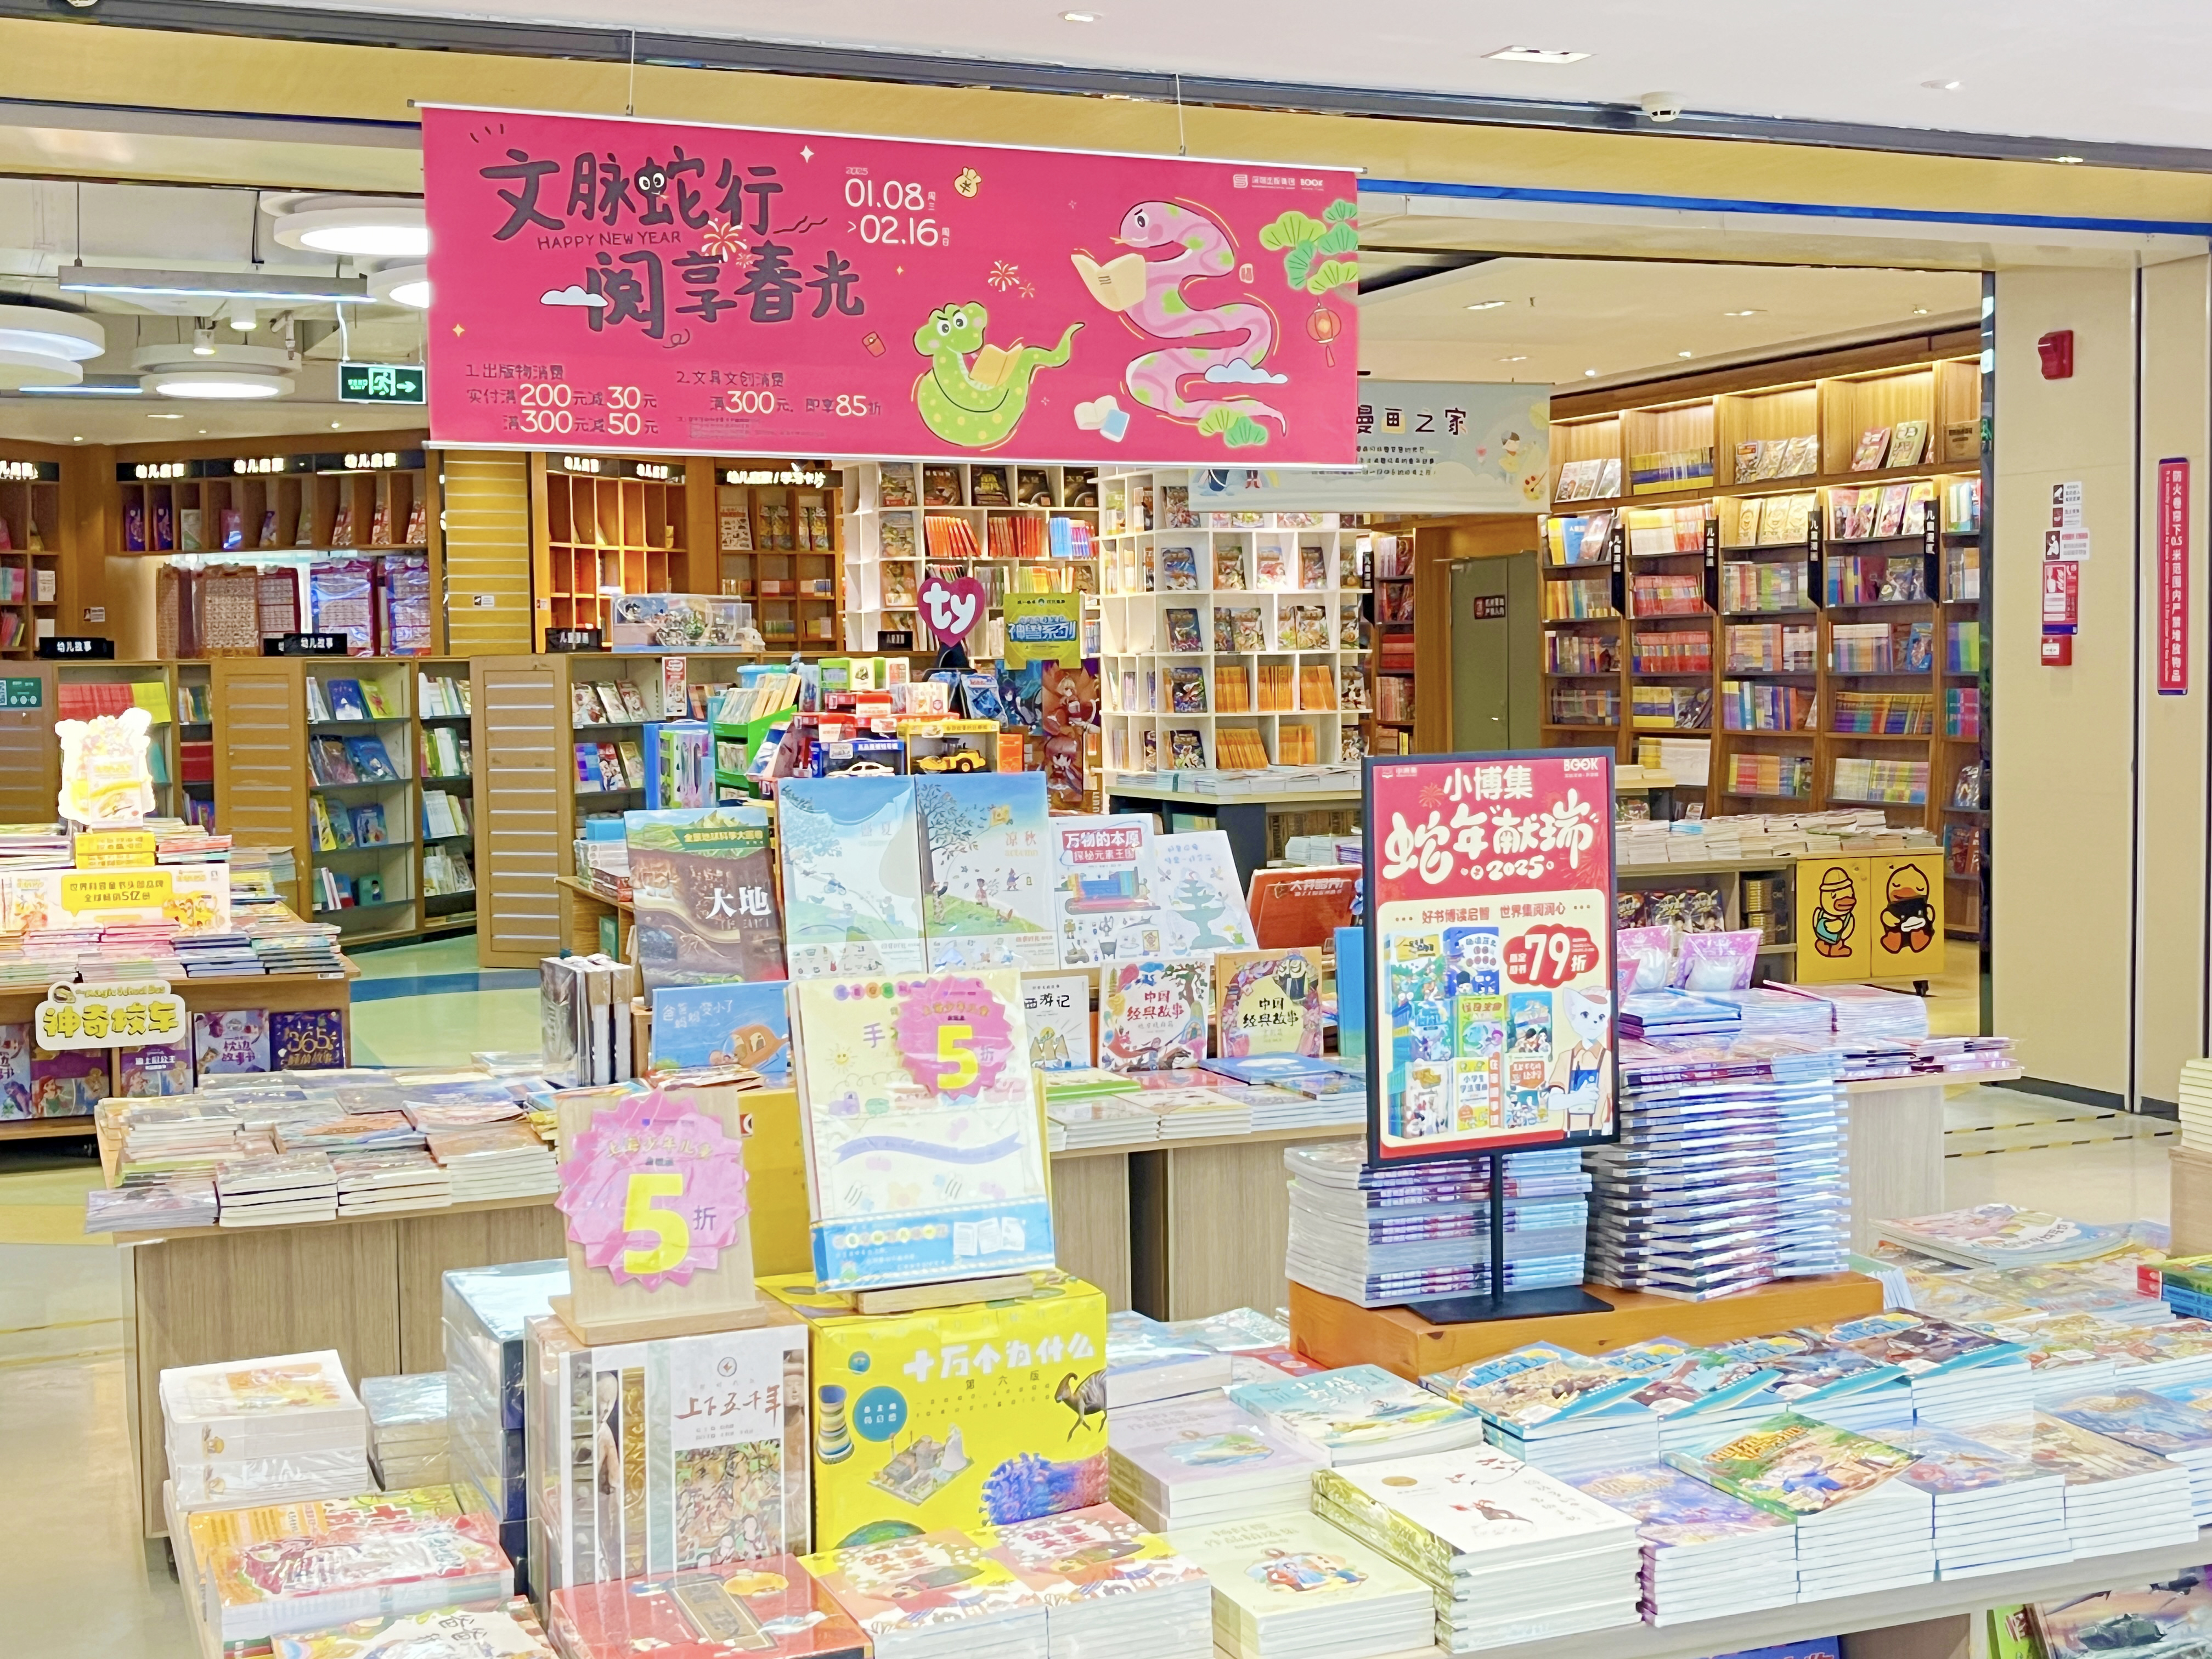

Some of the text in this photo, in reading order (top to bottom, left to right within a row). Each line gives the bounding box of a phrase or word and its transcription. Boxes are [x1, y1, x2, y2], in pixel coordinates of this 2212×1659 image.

[479, 145, 783, 241] 文脉蛇行
[845, 178, 924, 211] 01.08
[538, 231, 681, 251] HAPPY NEW YEAR
[586, 240, 865, 340] 阅享春光
[923, 582, 977, 634] ty
[1563, 757, 1599, 772] BOOK
[1443, 764, 1533, 802] 小博集
[1382, 787, 1594, 885] 蛇年献瑞
[1486, 855, 1545, 881] 2025
[704, 885, 772, 920] 大地
[1524, 932, 1572, 981] 79
[1024, 994, 1070, 1009] 西游记
[1126, 1002, 1184, 1021] 经典故事
[1144, 990, 1170, 1003] 中国
[1259, 996, 1284, 1011] 中国
[43, 1001, 179, 1038] 神奇校车
[863, 1022, 885, 1048] 手
[1243, 1011, 1299, 1029] 经典故事
[937, 1024, 979, 1091] 5
[623, 1173, 690, 1274] 5
[903, 1331, 1095, 1383] 十万个为什么
[674, 1384, 782, 1427] 上下五千年
